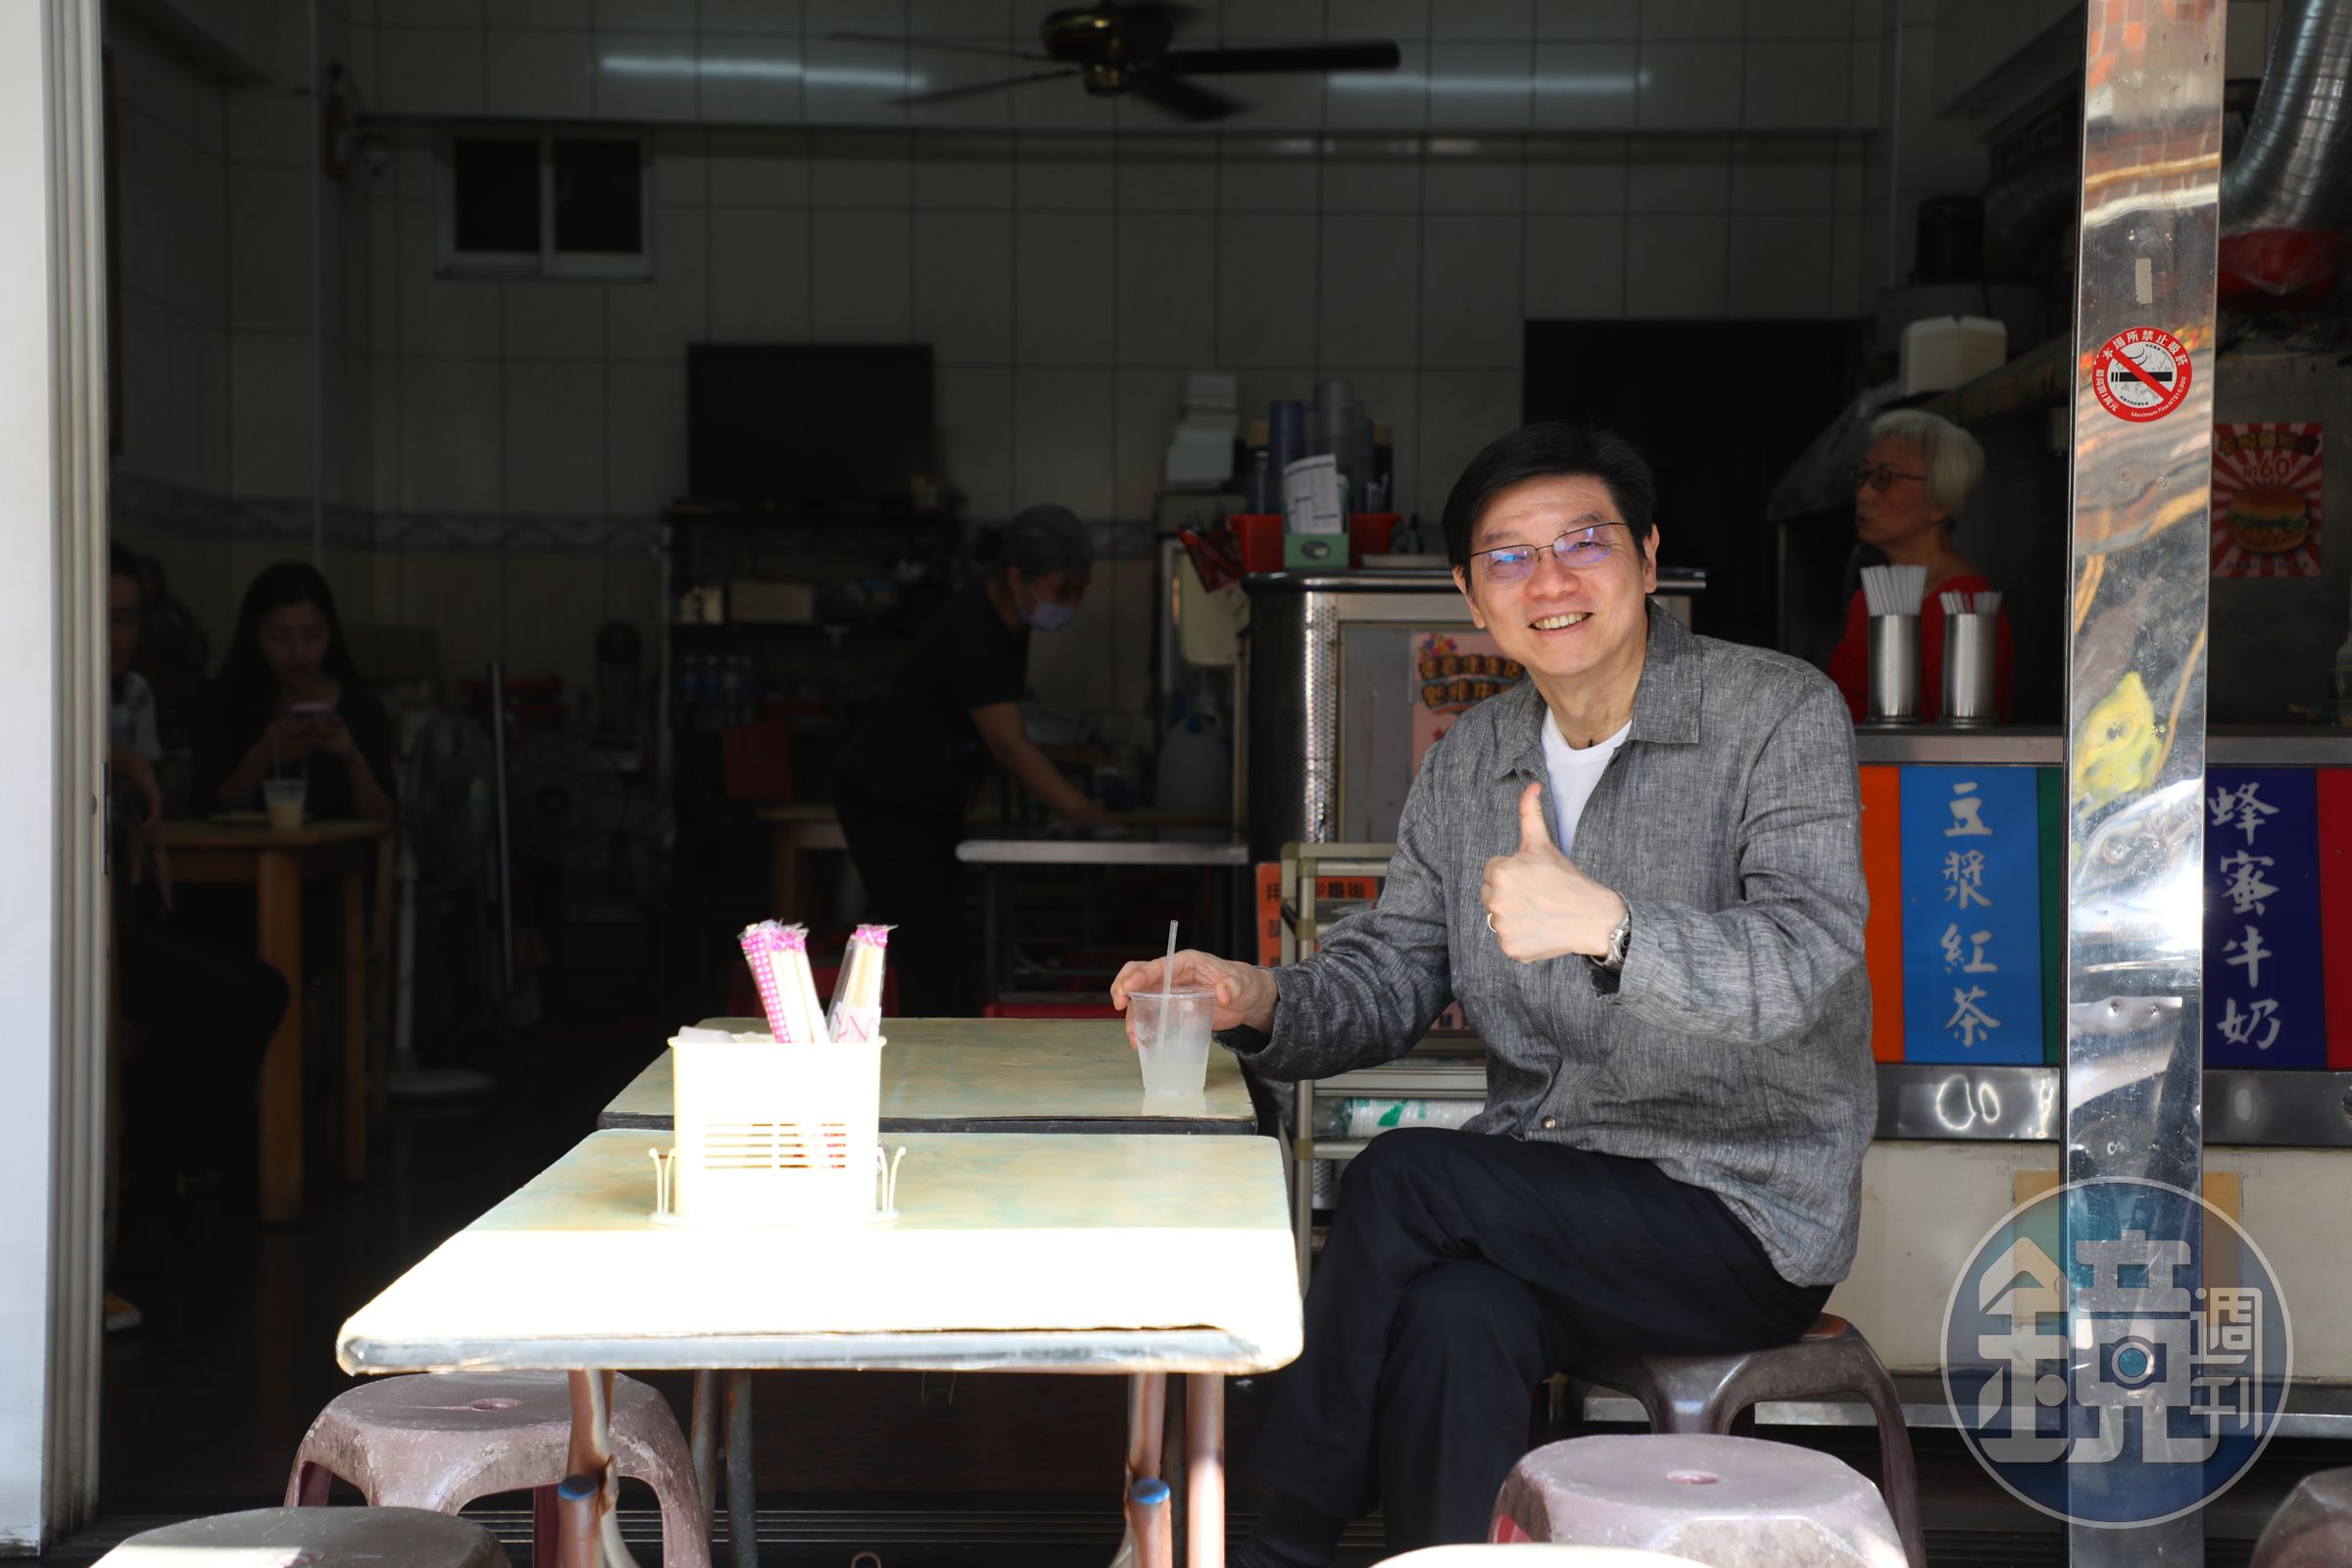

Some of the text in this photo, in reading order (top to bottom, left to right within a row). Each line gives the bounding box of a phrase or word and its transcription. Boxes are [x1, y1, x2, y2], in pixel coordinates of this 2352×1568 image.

[2131, 409, 2159, 418] Maximum
[1939, 781, 2002, 1048] 豆漿紅茶
[2207, 781, 2281, 1051] 蜂蜜牛奶
